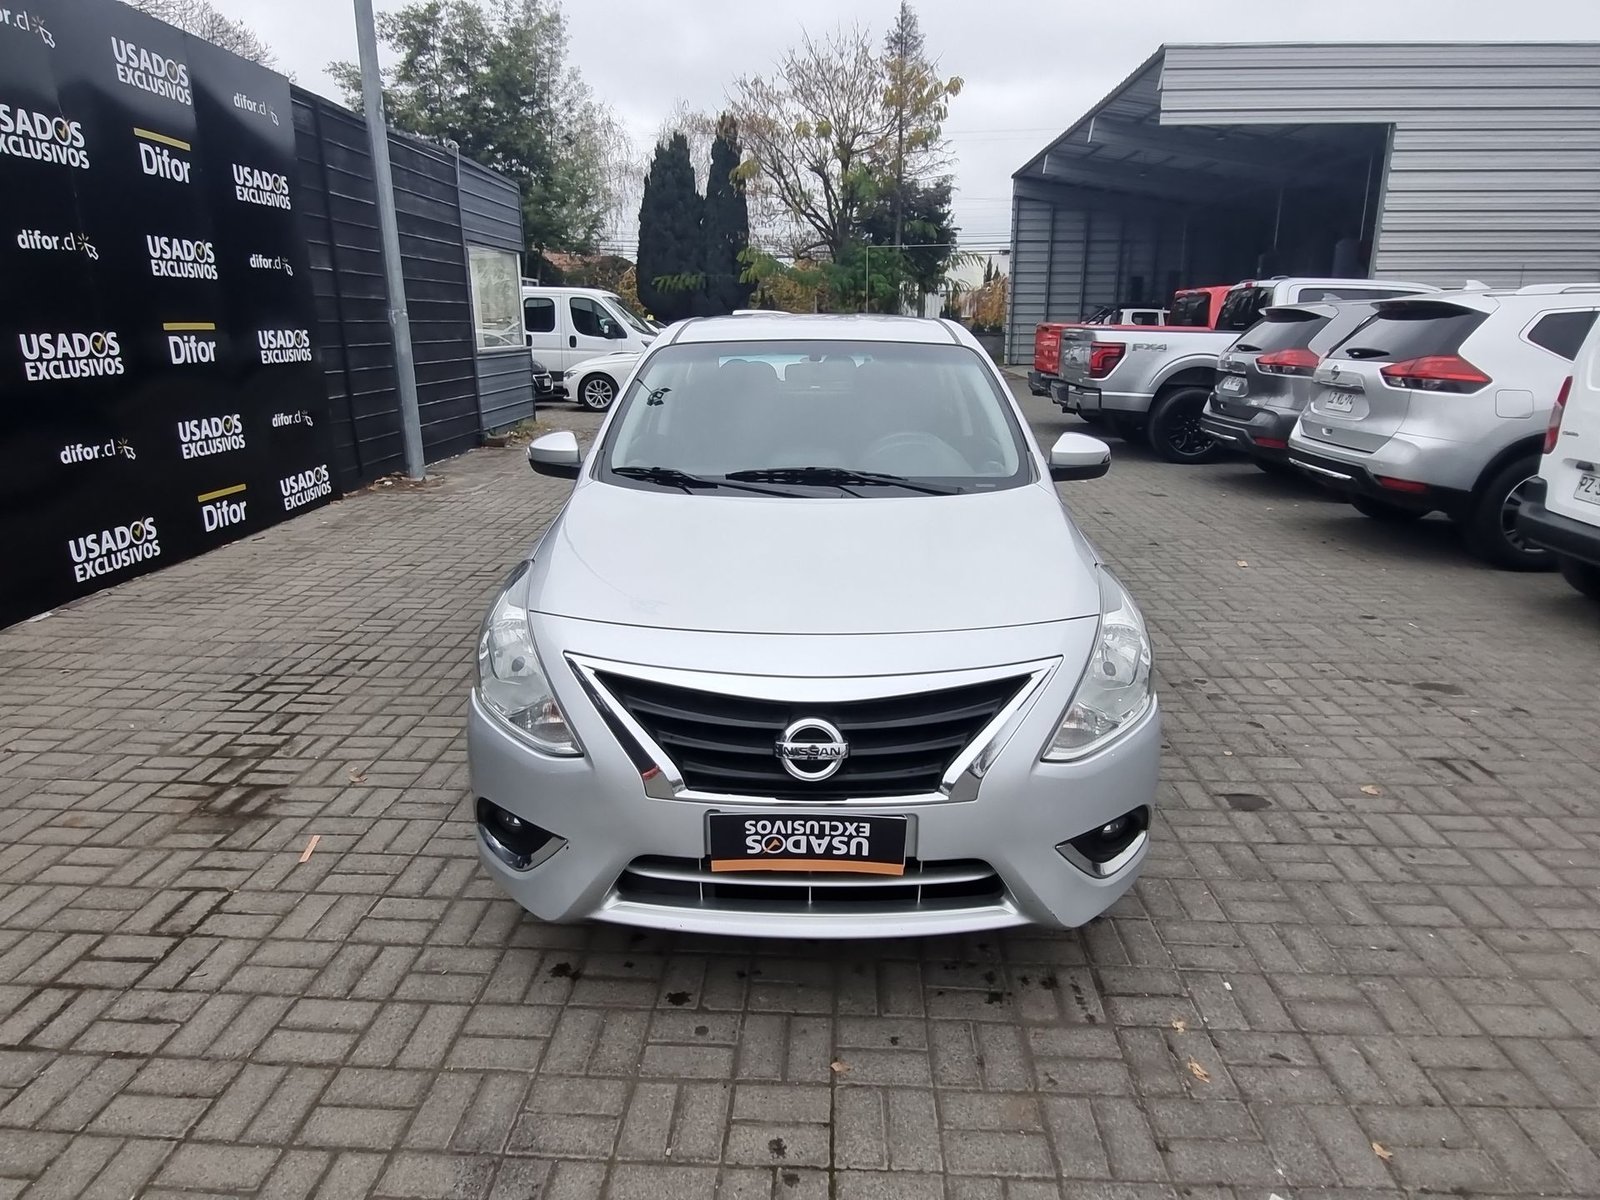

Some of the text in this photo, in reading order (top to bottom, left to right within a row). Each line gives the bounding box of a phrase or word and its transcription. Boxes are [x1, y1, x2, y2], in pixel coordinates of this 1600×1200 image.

[111, 37, 189, 86] USADOS
[116, 63, 191, 105] EXCLUSIVOS
[233, 93, 267, 115] difor.cl
[139, 143, 190, 183] Difor
[232, 164, 289, 195] USADOS
[235, 186, 291, 210] EXCLUSIVOS
[17, 229, 76, 250] difor.cl
[147, 235, 215, 263] USADOS
[150, 259, 218, 280] EXCLUSIVOS
[250, 254, 282, 269] difor.cl
[19, 331, 120, 360] USADOS
[168, 335, 216, 364] Difor
[258, 330, 309, 349] USADOS
[1132, 343, 1167, 352] FX4
[260, 347, 312, 364] EXCLUSIVOS
[25, 357, 124, 381] EXCLUSIVOS
[178, 414, 242, 442] USADOS
[272, 411, 301, 427] difor.cl
[60, 439, 116, 464] difor.cl
[181, 434, 245, 459] EXCLUSIVOS
[280, 464, 329, 496] USADOS
[284, 481, 332, 511] EXCLUSIVOS
[202, 500, 247, 532] Difor
[69, 517, 157, 562] USADOS
[74, 540, 160, 583] EXCLUSIVOS
[783, 746, 841, 756] NISSAN
[744, 820, 870, 836] EXCLUSIVOS
[746, 834, 869, 856] USADOS
